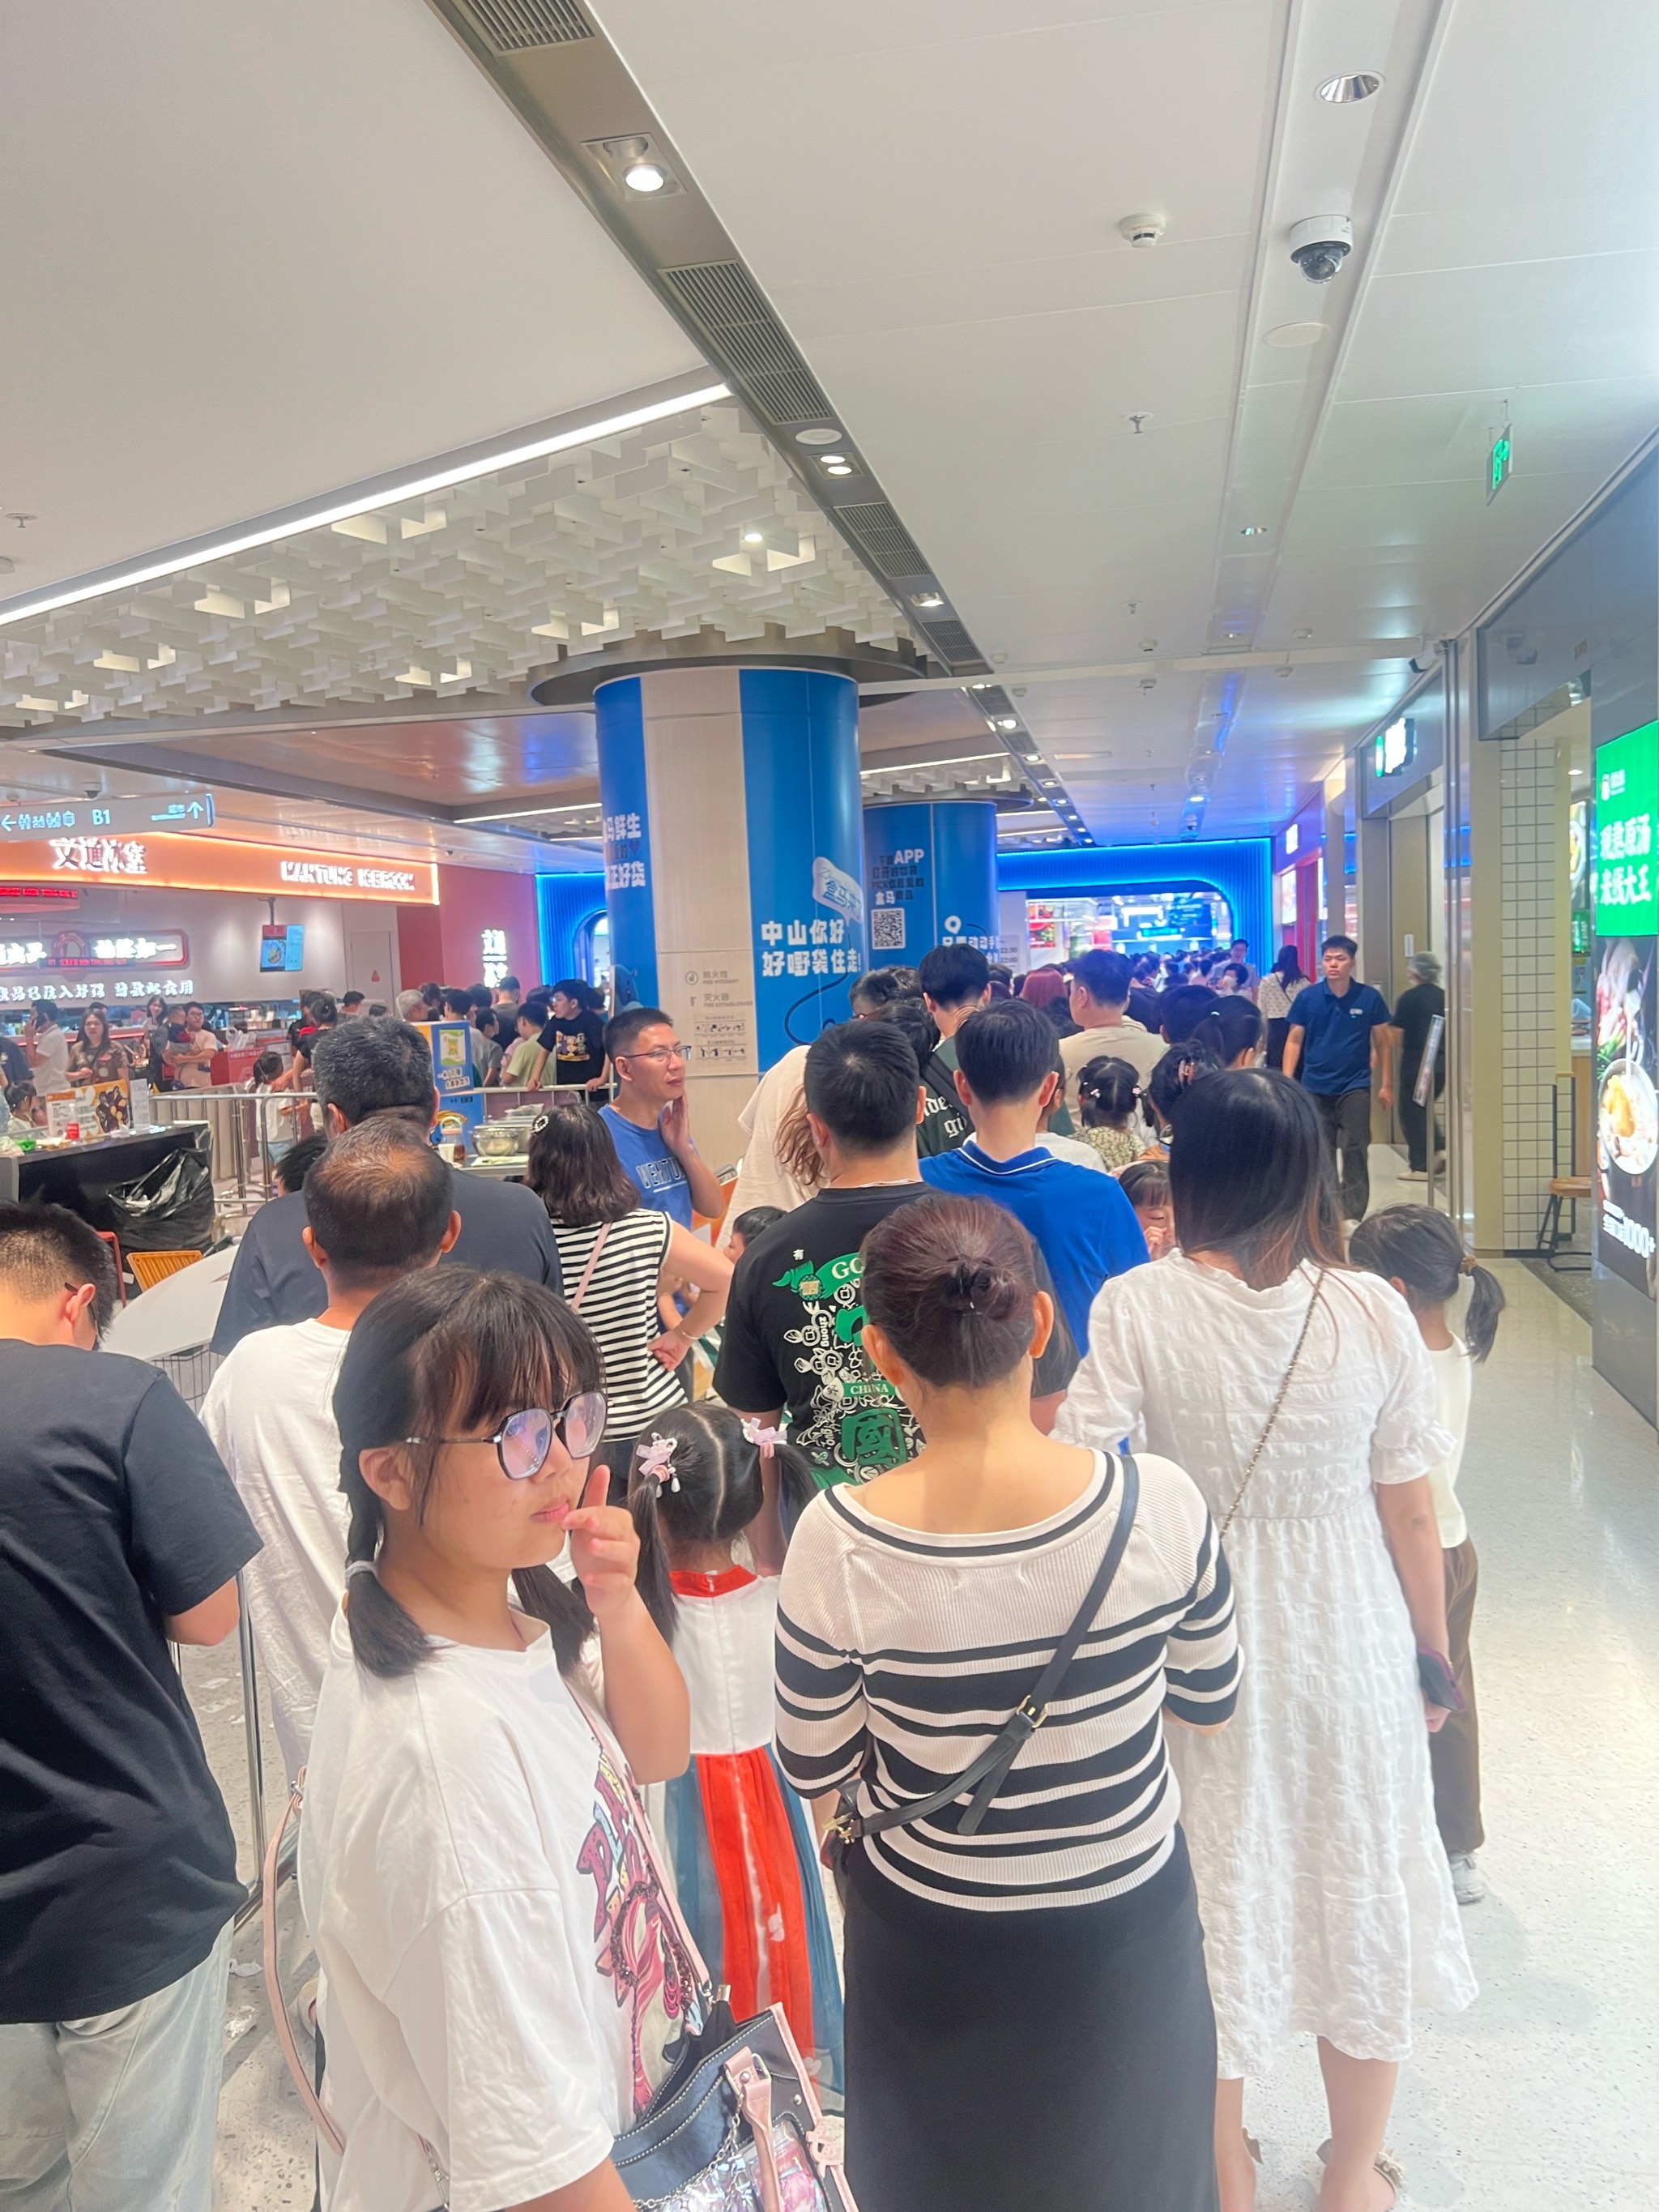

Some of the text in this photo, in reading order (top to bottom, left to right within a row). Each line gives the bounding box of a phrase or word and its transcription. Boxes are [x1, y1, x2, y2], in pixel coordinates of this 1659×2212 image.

[92, 809, 111, 826] B1
[761, 919, 844, 946] 中山你好
[818, 1316, 830, 1347] zhong
[850, 1383, 889, 1394] CHINA
